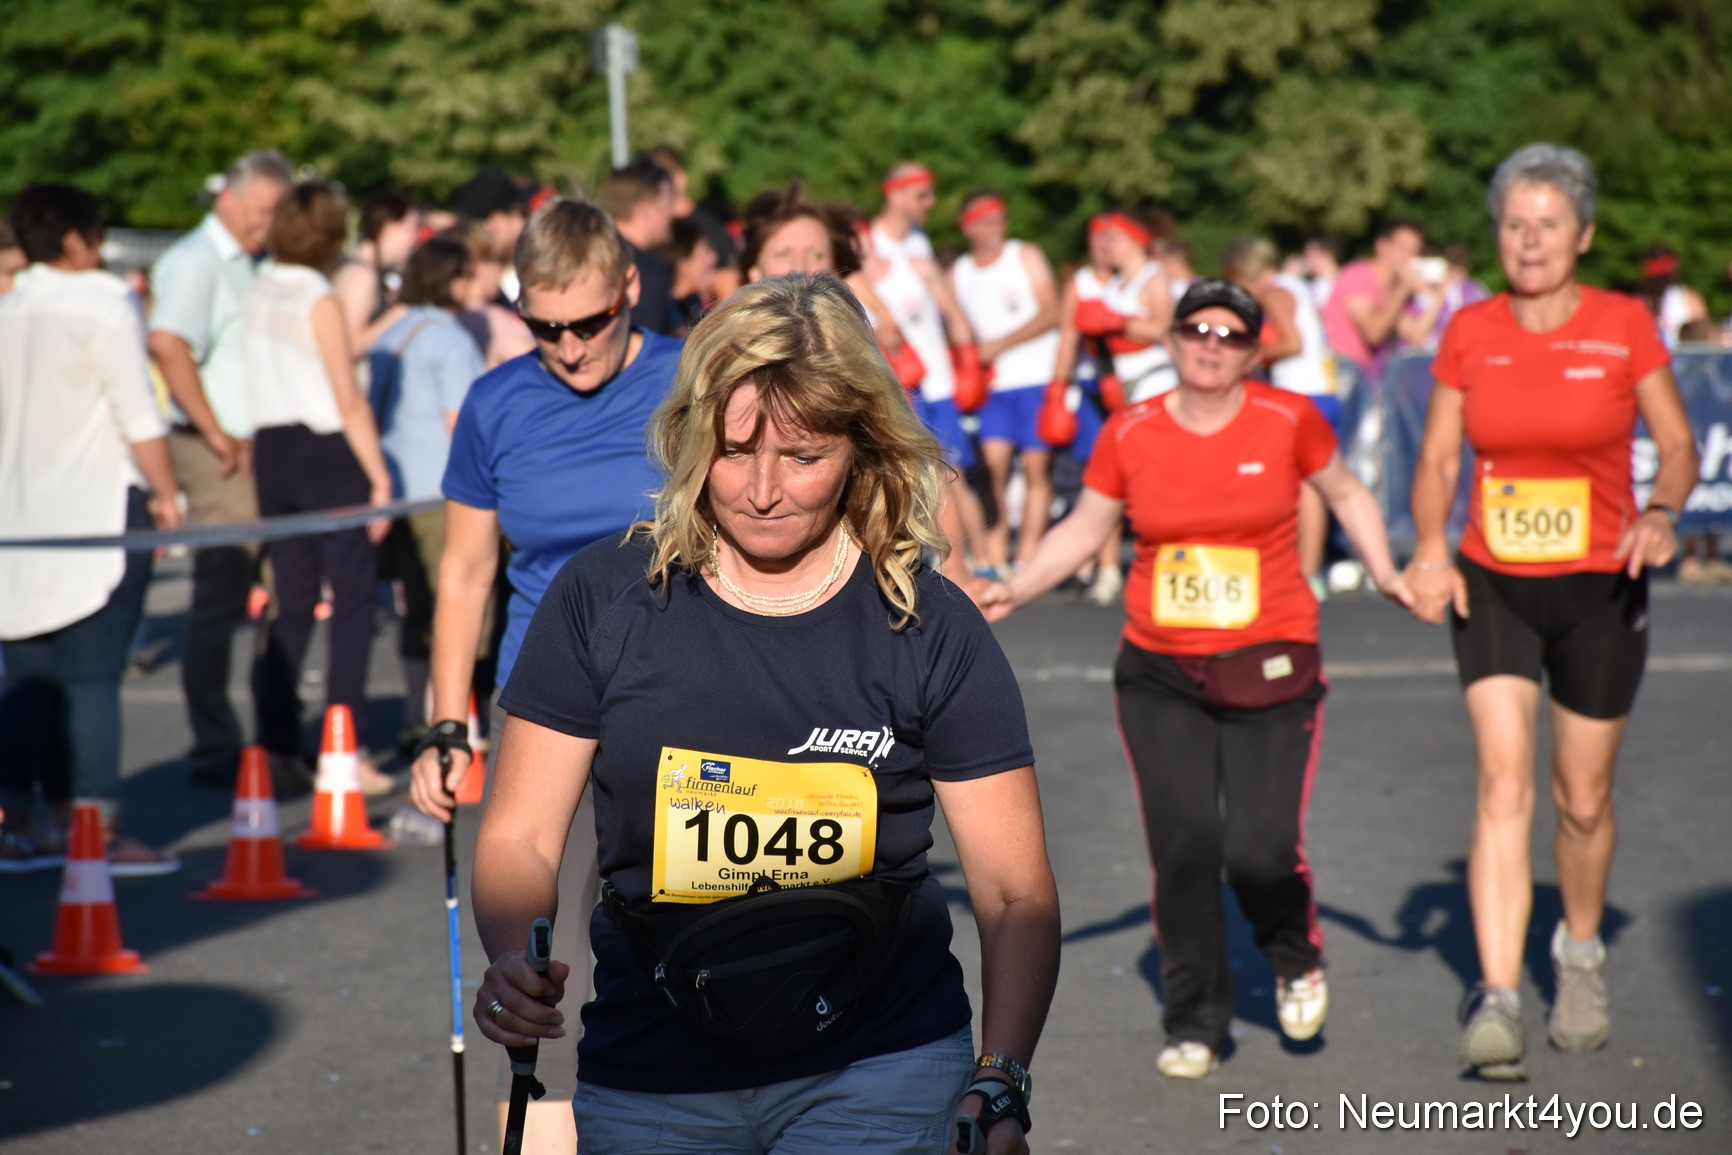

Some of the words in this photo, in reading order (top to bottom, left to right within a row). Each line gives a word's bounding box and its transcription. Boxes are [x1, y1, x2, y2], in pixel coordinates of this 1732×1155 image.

[1497, 508, 1573, 536] 1500
[1167, 573, 1242, 604] 1506
[788, 727, 881, 755] JURA
[810, 745, 833, 753] SPORT
[840, 747, 868, 757] SERVICE
[685, 789, 717, 797] neumarkt
[686, 776, 758, 797] firmenlauf
[670, 797, 726, 815] walken
[765, 797, 805, 810] 2018
[684, 809, 845, 866] 1048
[718, 867, 766, 882] Gimpl
[772, 868, 809, 881] Erna
[691, 881, 750, 891] Lebenshilf
[758, 881, 810, 891] Nemarkt
[991, 1095, 1012, 1113] LEKI
